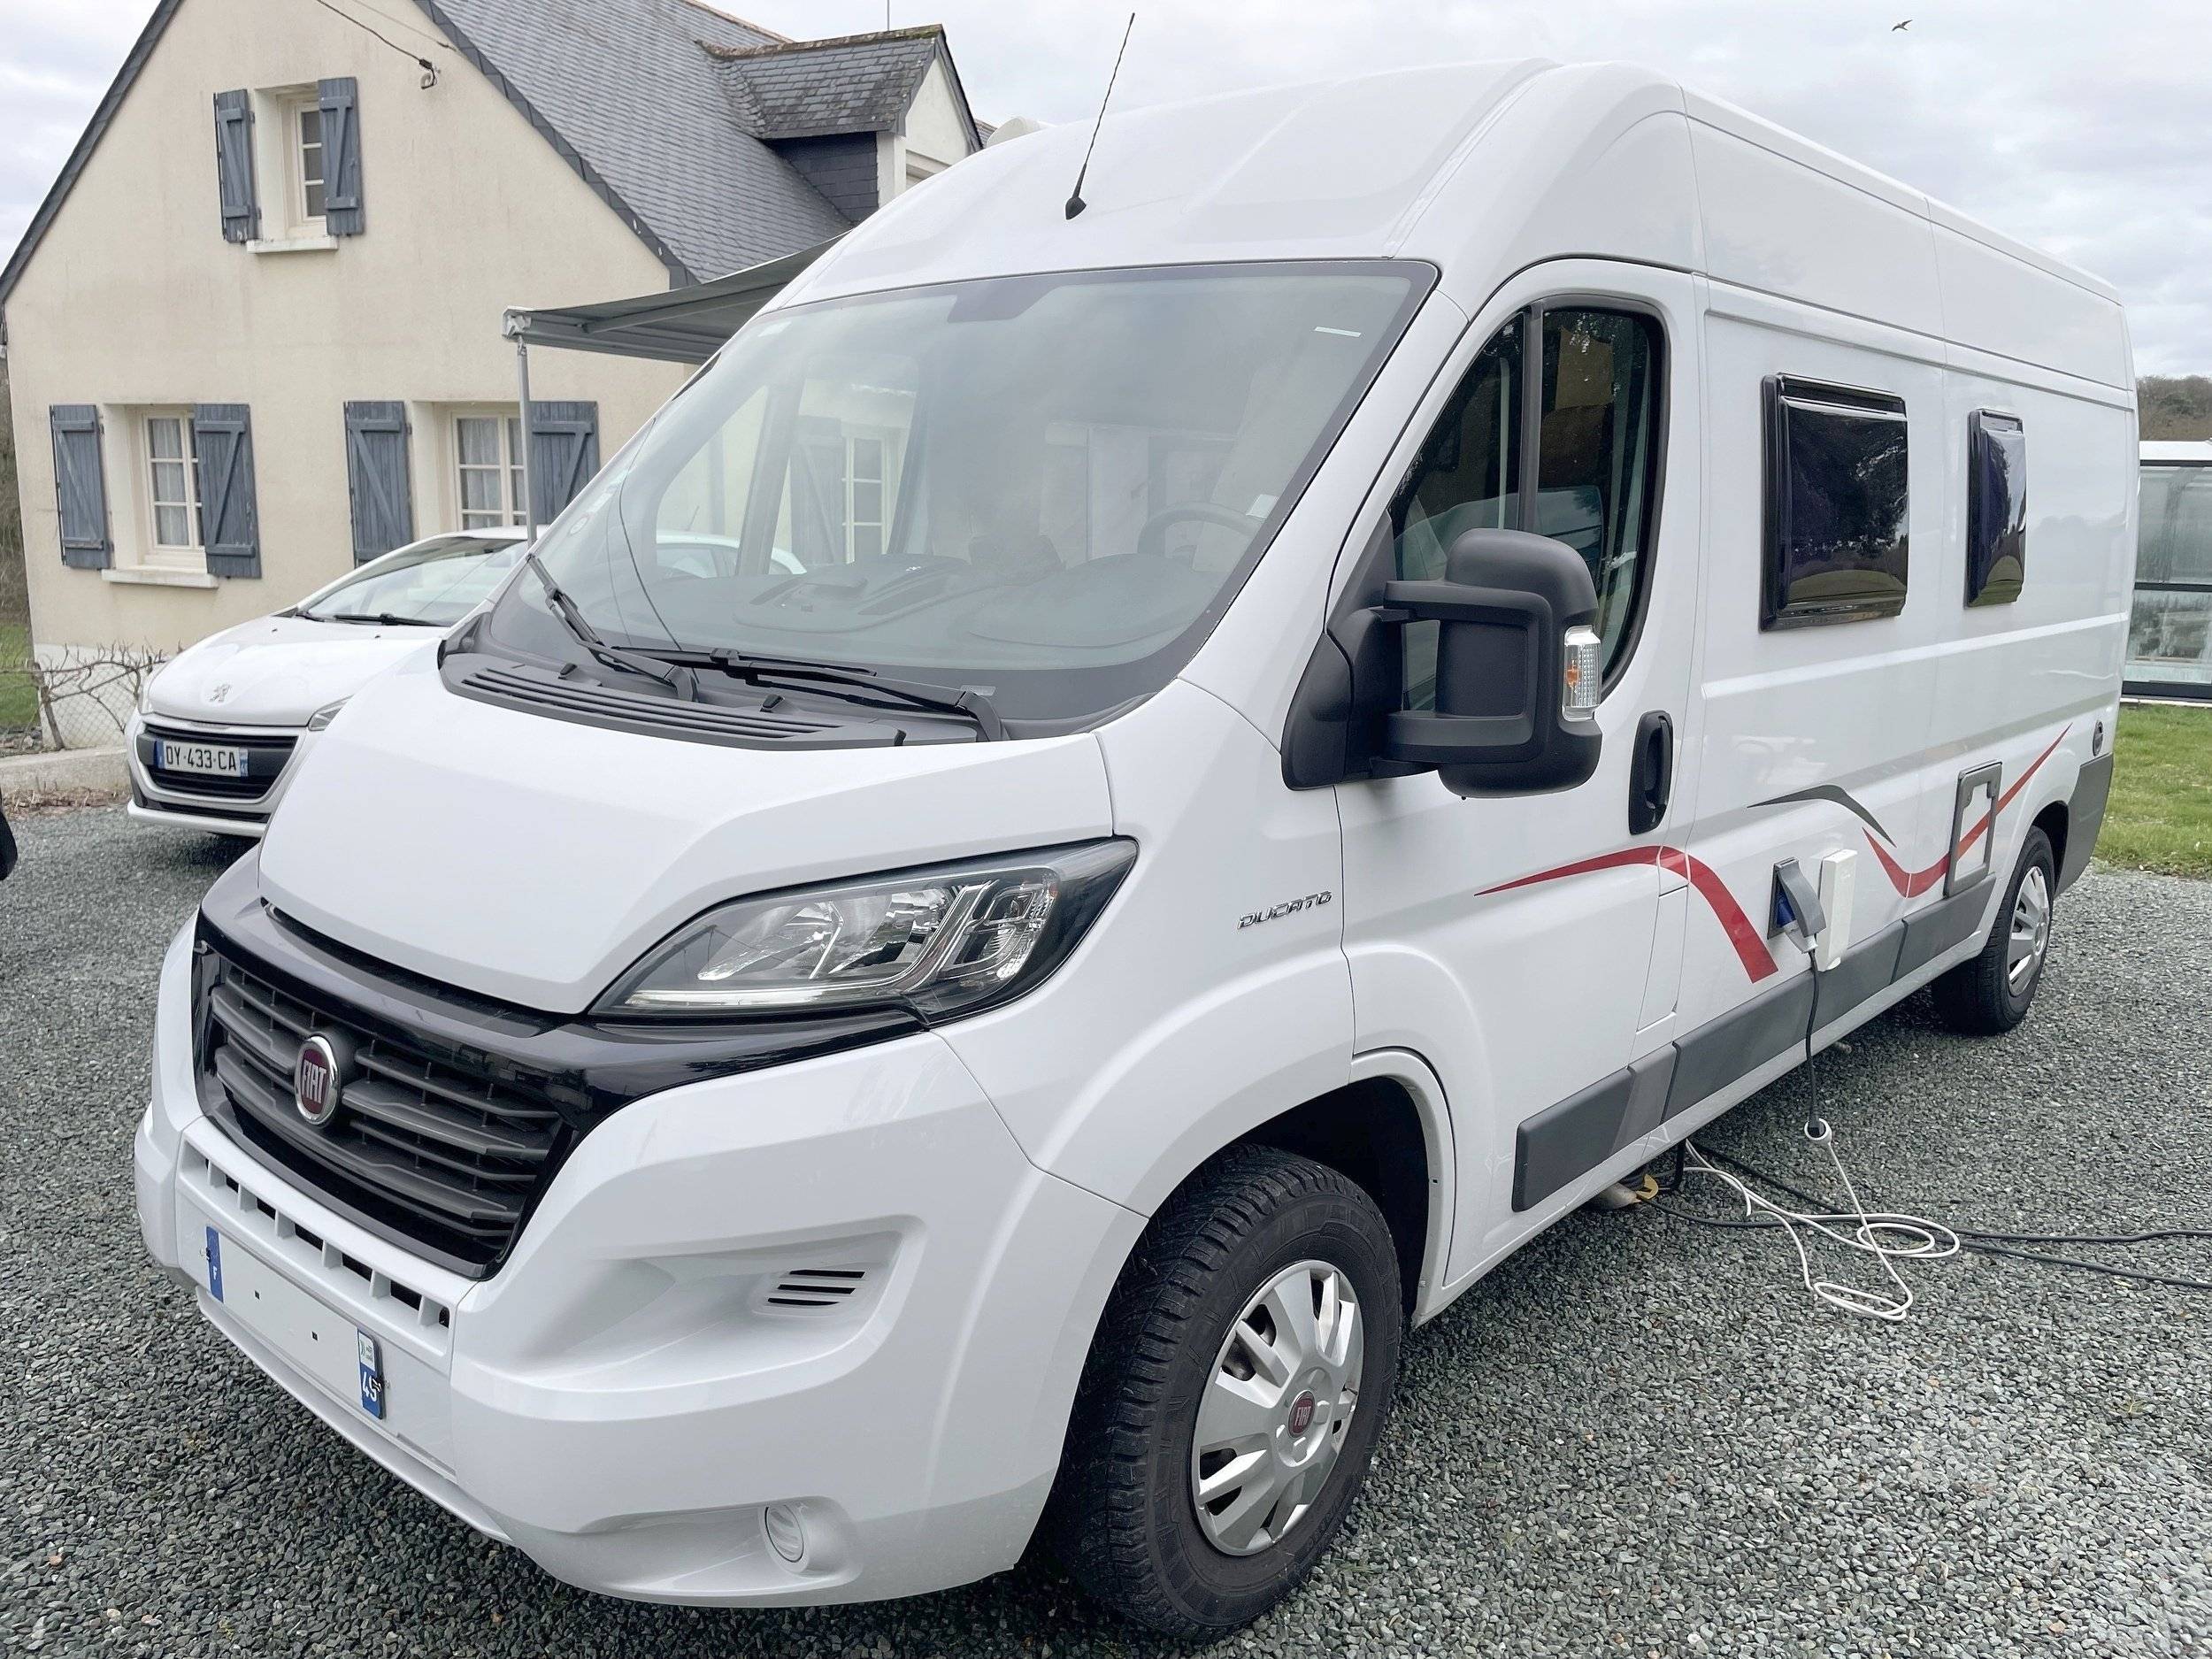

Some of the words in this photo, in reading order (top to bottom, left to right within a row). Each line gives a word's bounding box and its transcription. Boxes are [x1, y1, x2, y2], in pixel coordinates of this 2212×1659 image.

[1237, 890, 1333, 930] DUCATO
[302, 1059, 327, 1104] FIAT
[1294, 1406, 1312, 1426] FIAT
